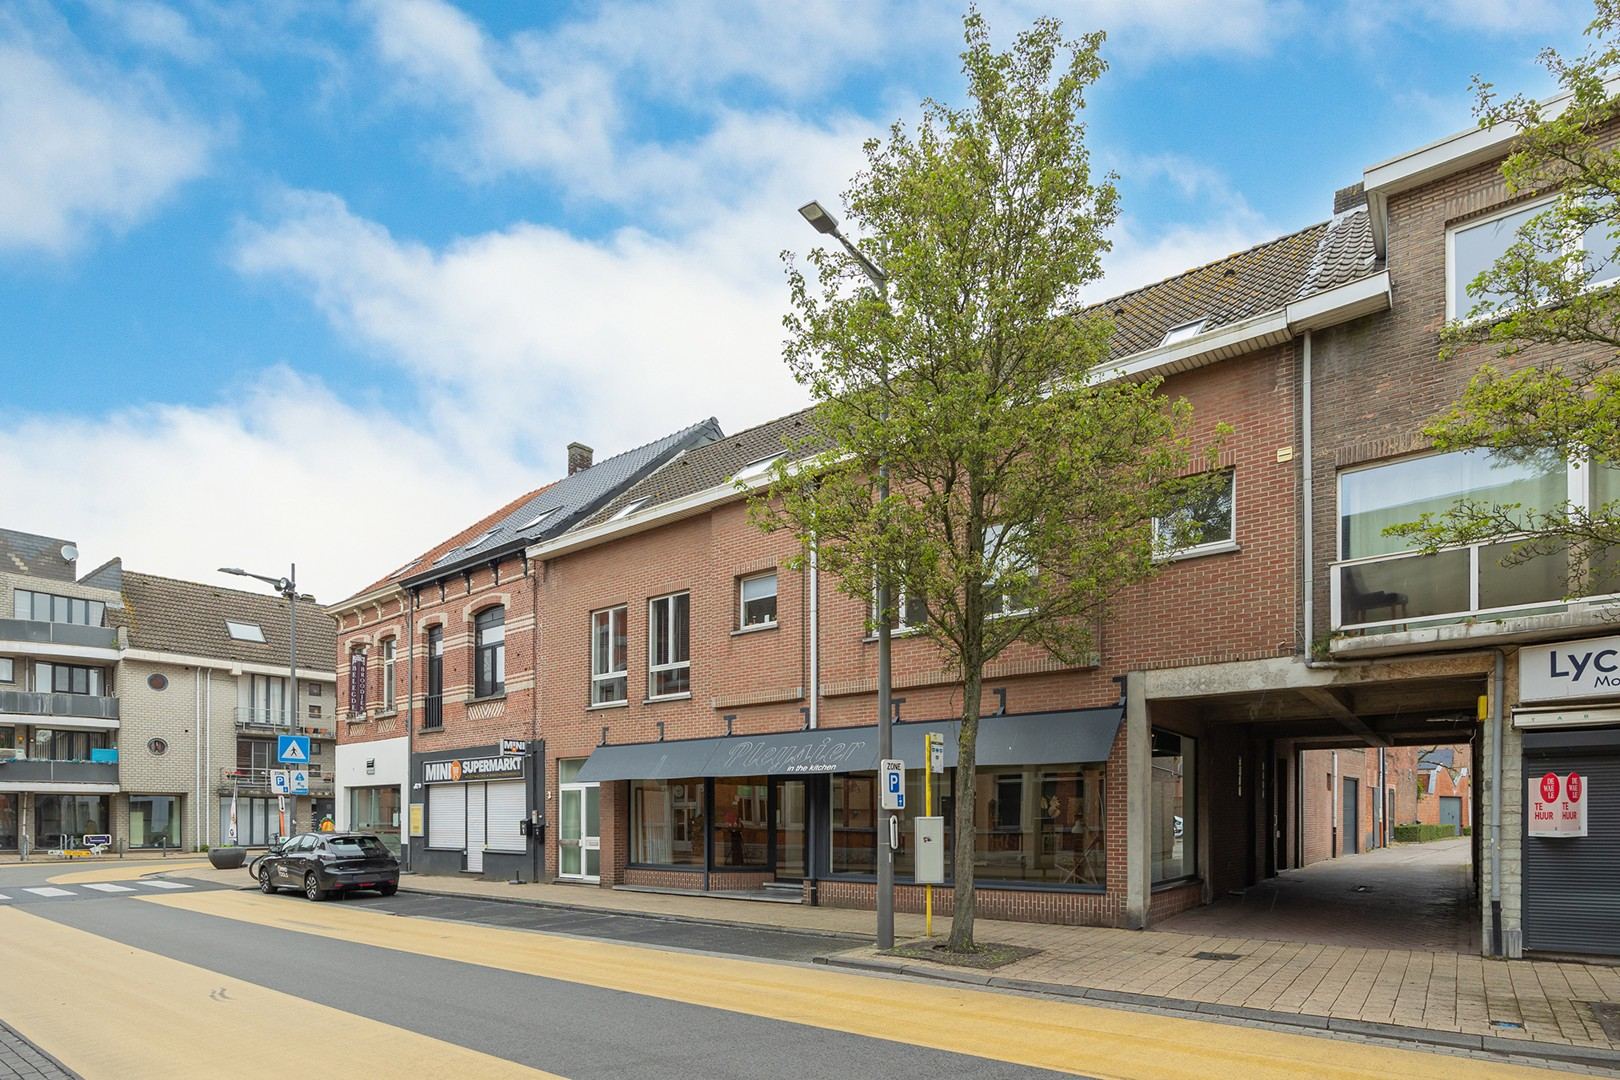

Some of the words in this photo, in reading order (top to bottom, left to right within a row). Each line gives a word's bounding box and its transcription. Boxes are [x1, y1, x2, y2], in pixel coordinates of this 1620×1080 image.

[724, 736, 866, 773] Pleysier
[425, 762, 452, 781] MINI
[462, 756, 522, 774] SUPERMARKT
[808, 763, 837, 771] kitchen
[886, 762, 902, 771] ZONE
[1547, 777, 1555, 785] DE
[1534, 802, 1543, 811] TE
[1562, 801, 1569, 811] TE
[1534, 811, 1554, 820] HUUR
[1561, 811, 1577, 820] HUUR
